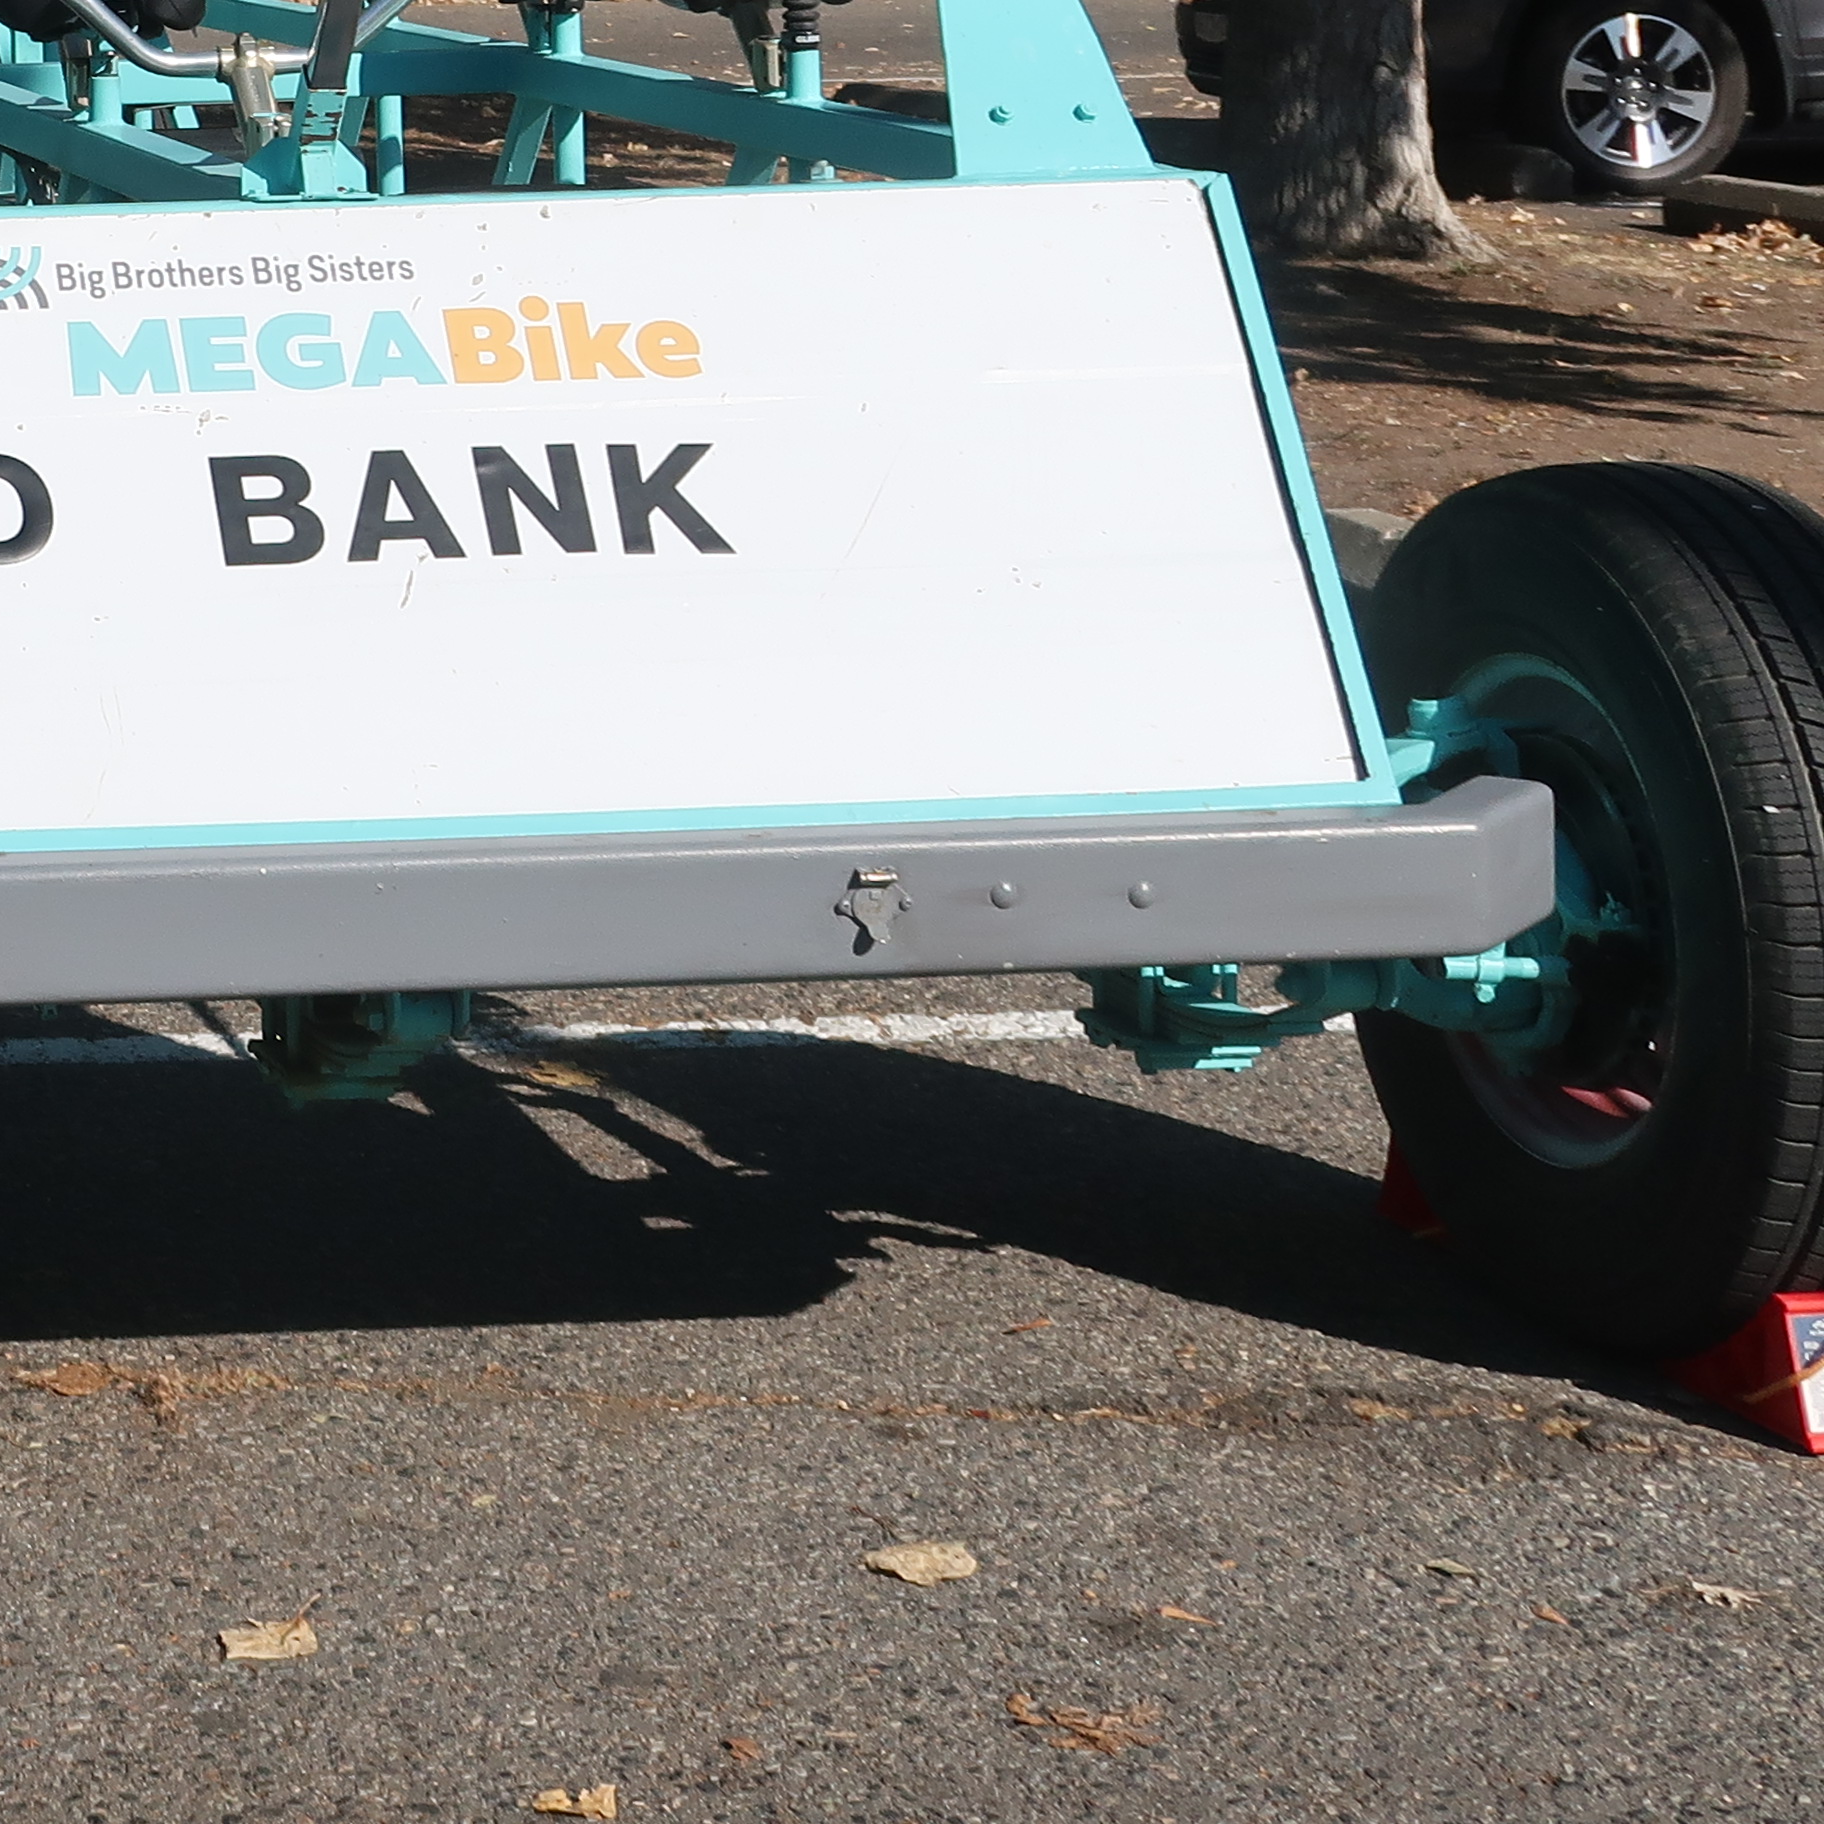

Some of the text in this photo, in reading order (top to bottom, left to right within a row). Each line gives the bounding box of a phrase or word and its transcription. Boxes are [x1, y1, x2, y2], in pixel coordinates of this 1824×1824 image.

[55, 254, 415, 300] Big Brothers Big Sisters
[66, 295, 703, 397] MEGABike
[208, 442, 738, 567] BANK
